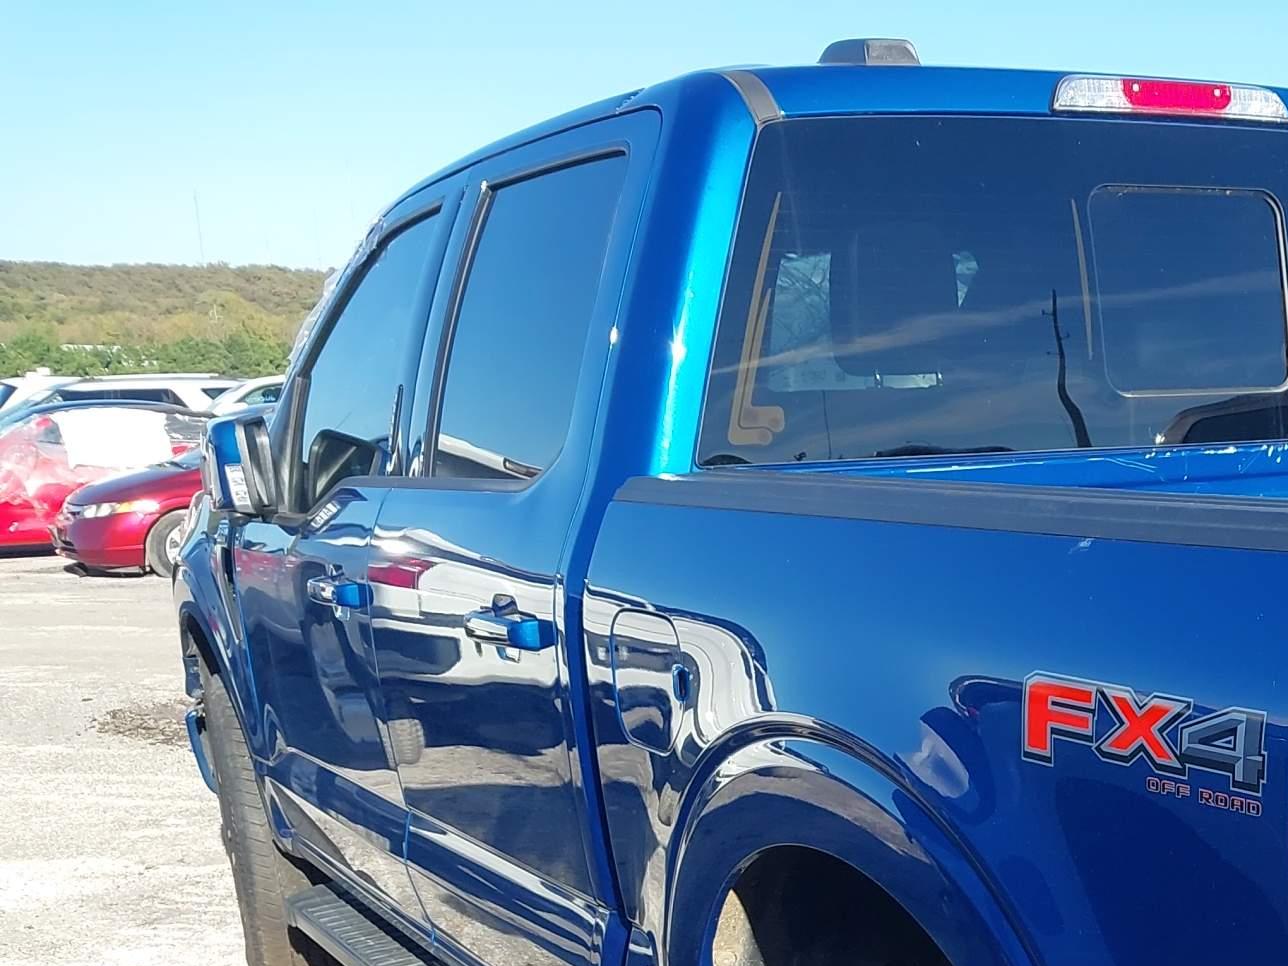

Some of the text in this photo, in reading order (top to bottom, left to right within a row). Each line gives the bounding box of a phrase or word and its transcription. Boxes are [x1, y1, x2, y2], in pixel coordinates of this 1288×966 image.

[1022, 671, 1267, 796] FX4
[1146, 777, 1262, 817] OFF ROAD
